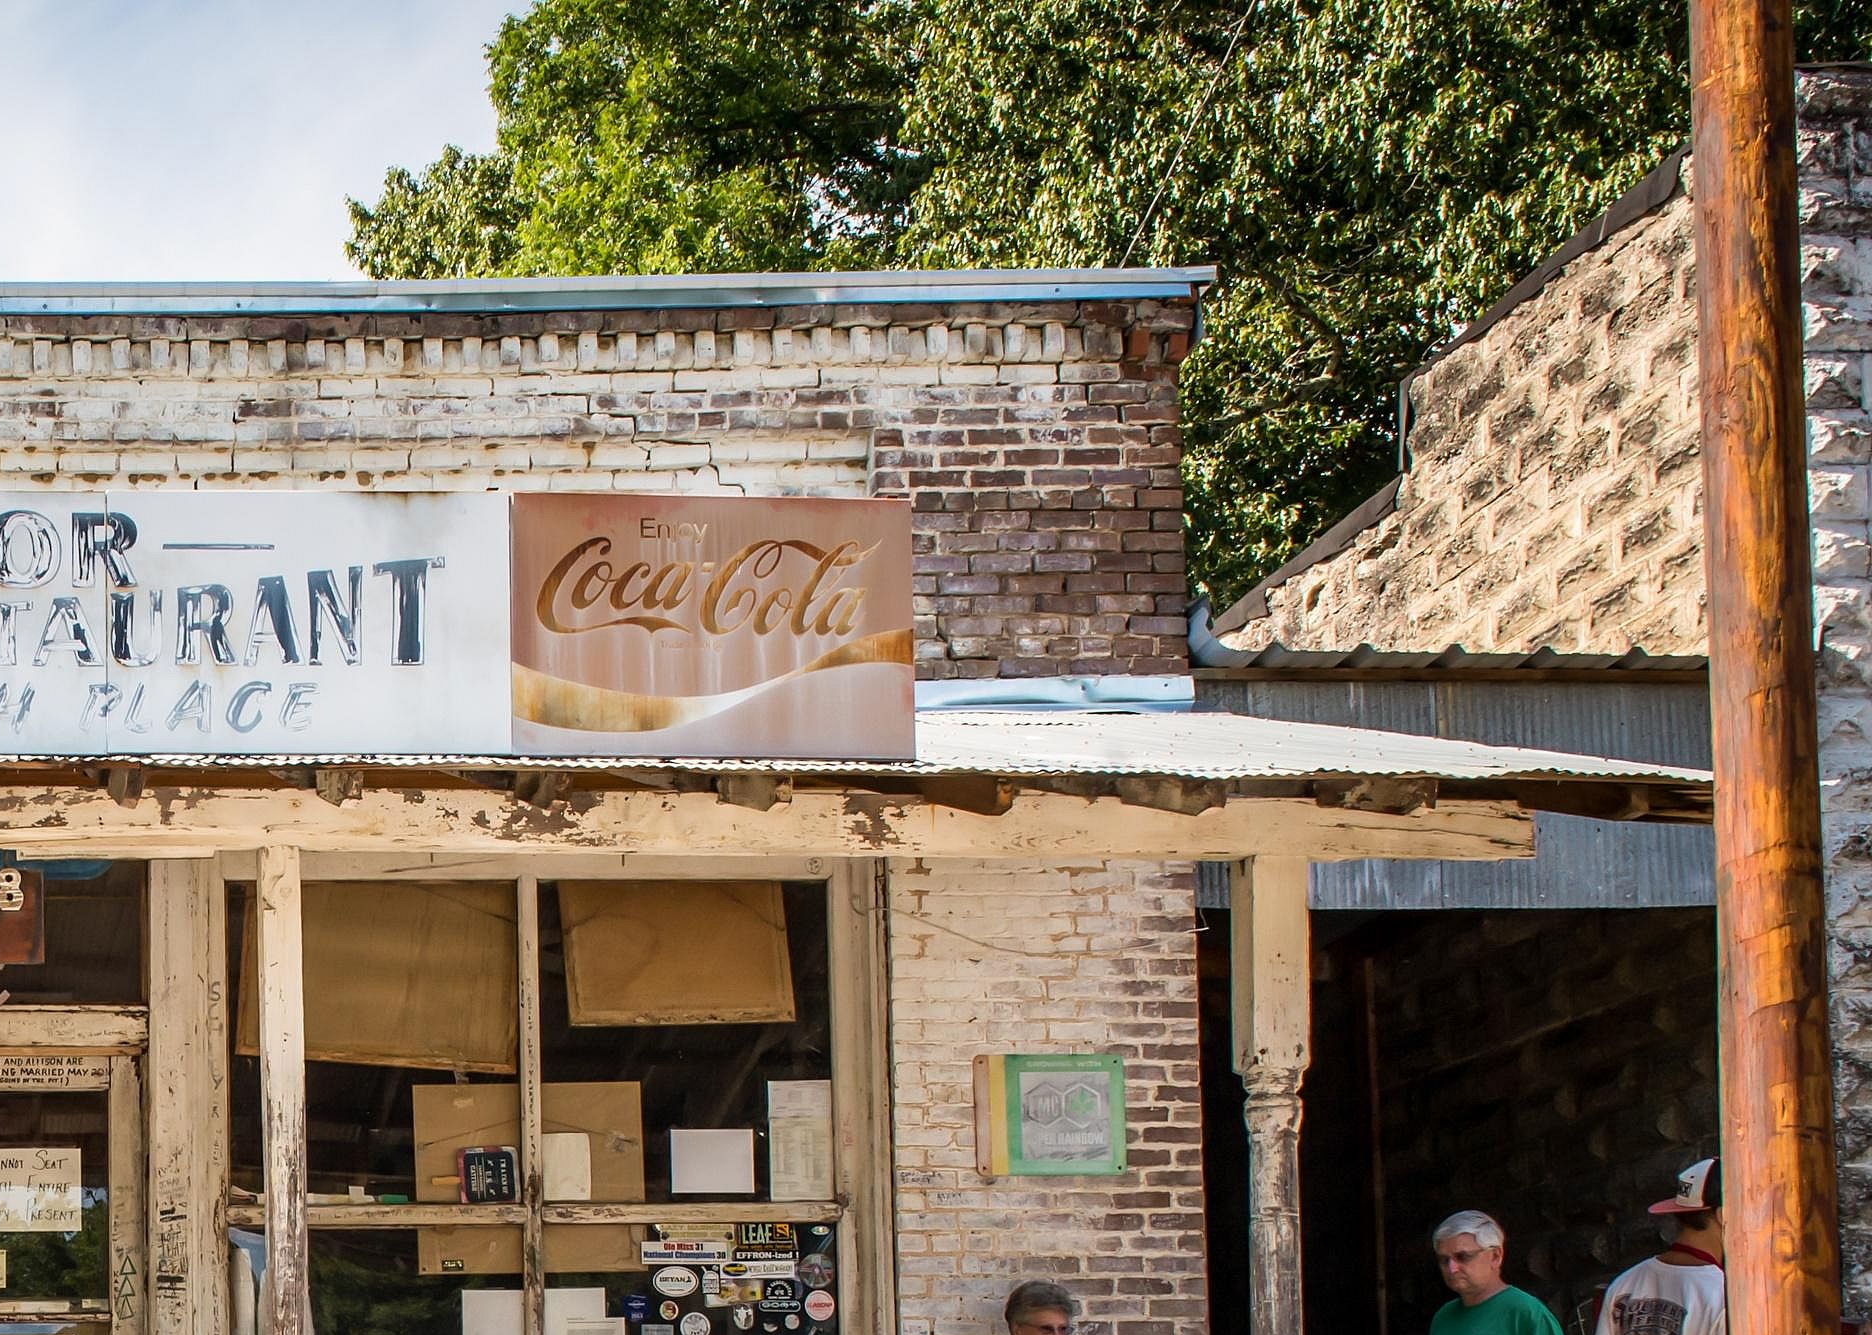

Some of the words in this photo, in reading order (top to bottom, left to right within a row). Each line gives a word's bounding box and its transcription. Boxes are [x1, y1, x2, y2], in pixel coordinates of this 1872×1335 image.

[639, 517, 708, 544] Enjoy
[536, 535, 883, 637] Coca-Cola
[78, 679, 321, 734] PLACE
[3, 1057, 23, 1066] AND
[66, 1057, 84, 1066] ARE
[19, 1067, 65, 1077] MARRIED
[67, 1068, 89, 1077] MAY
[31, 1150, 69, 1171] SEAT
